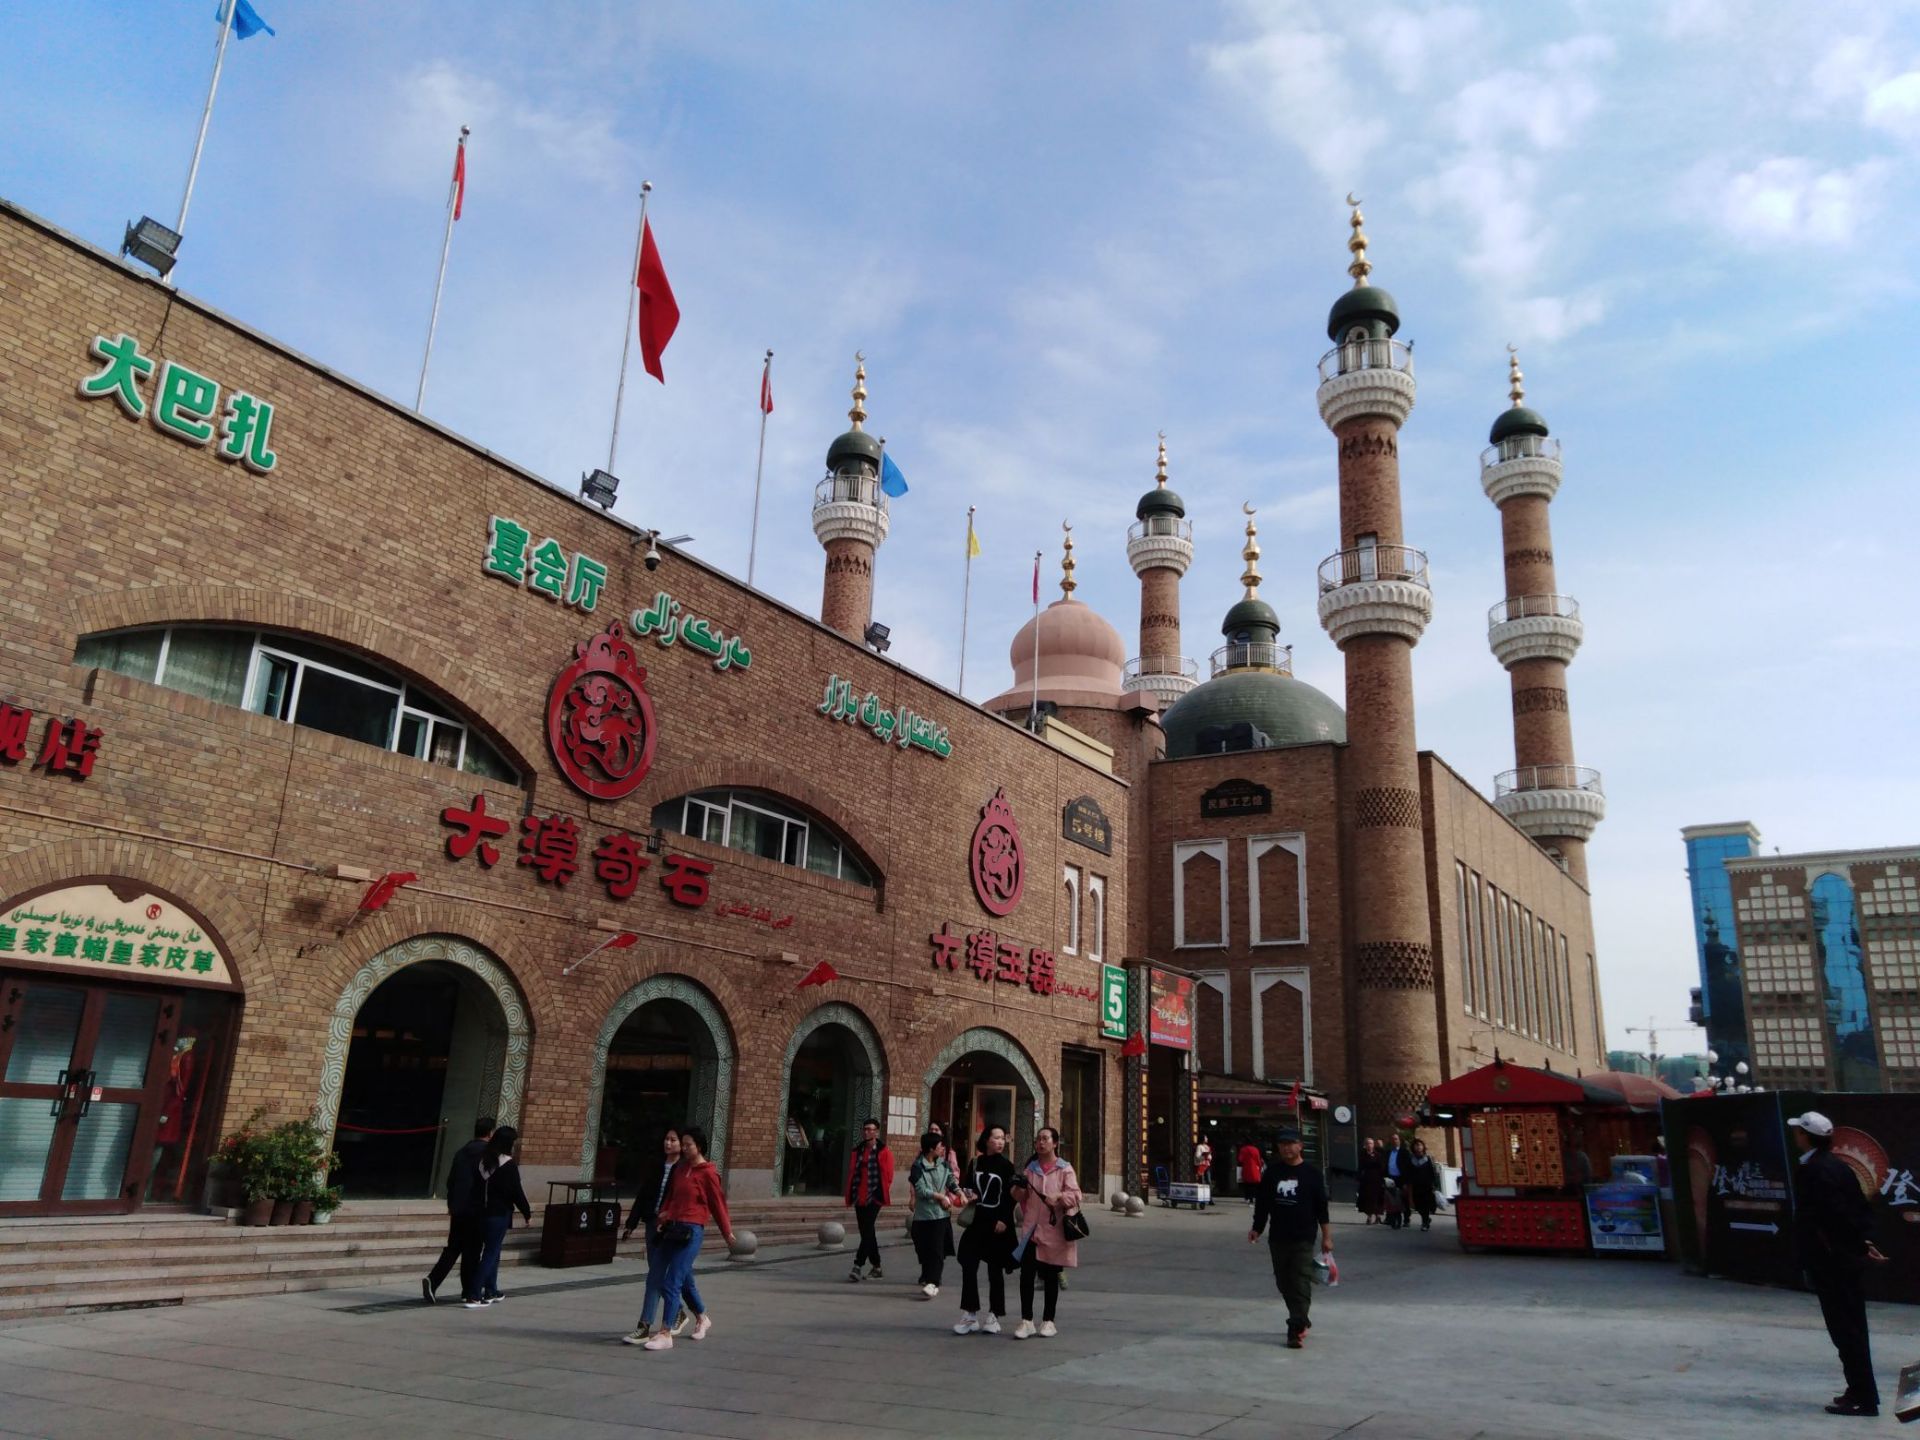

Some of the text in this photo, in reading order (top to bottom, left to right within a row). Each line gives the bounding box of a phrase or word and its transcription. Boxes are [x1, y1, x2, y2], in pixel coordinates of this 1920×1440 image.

[79, 333, 608, 612] 大巴扎 宴会厅
[442, 794, 714, 906] 大漠奇石
[931, 923, 1055, 993] 大漠玉器
[1108, 983, 1123, 1019] 5
